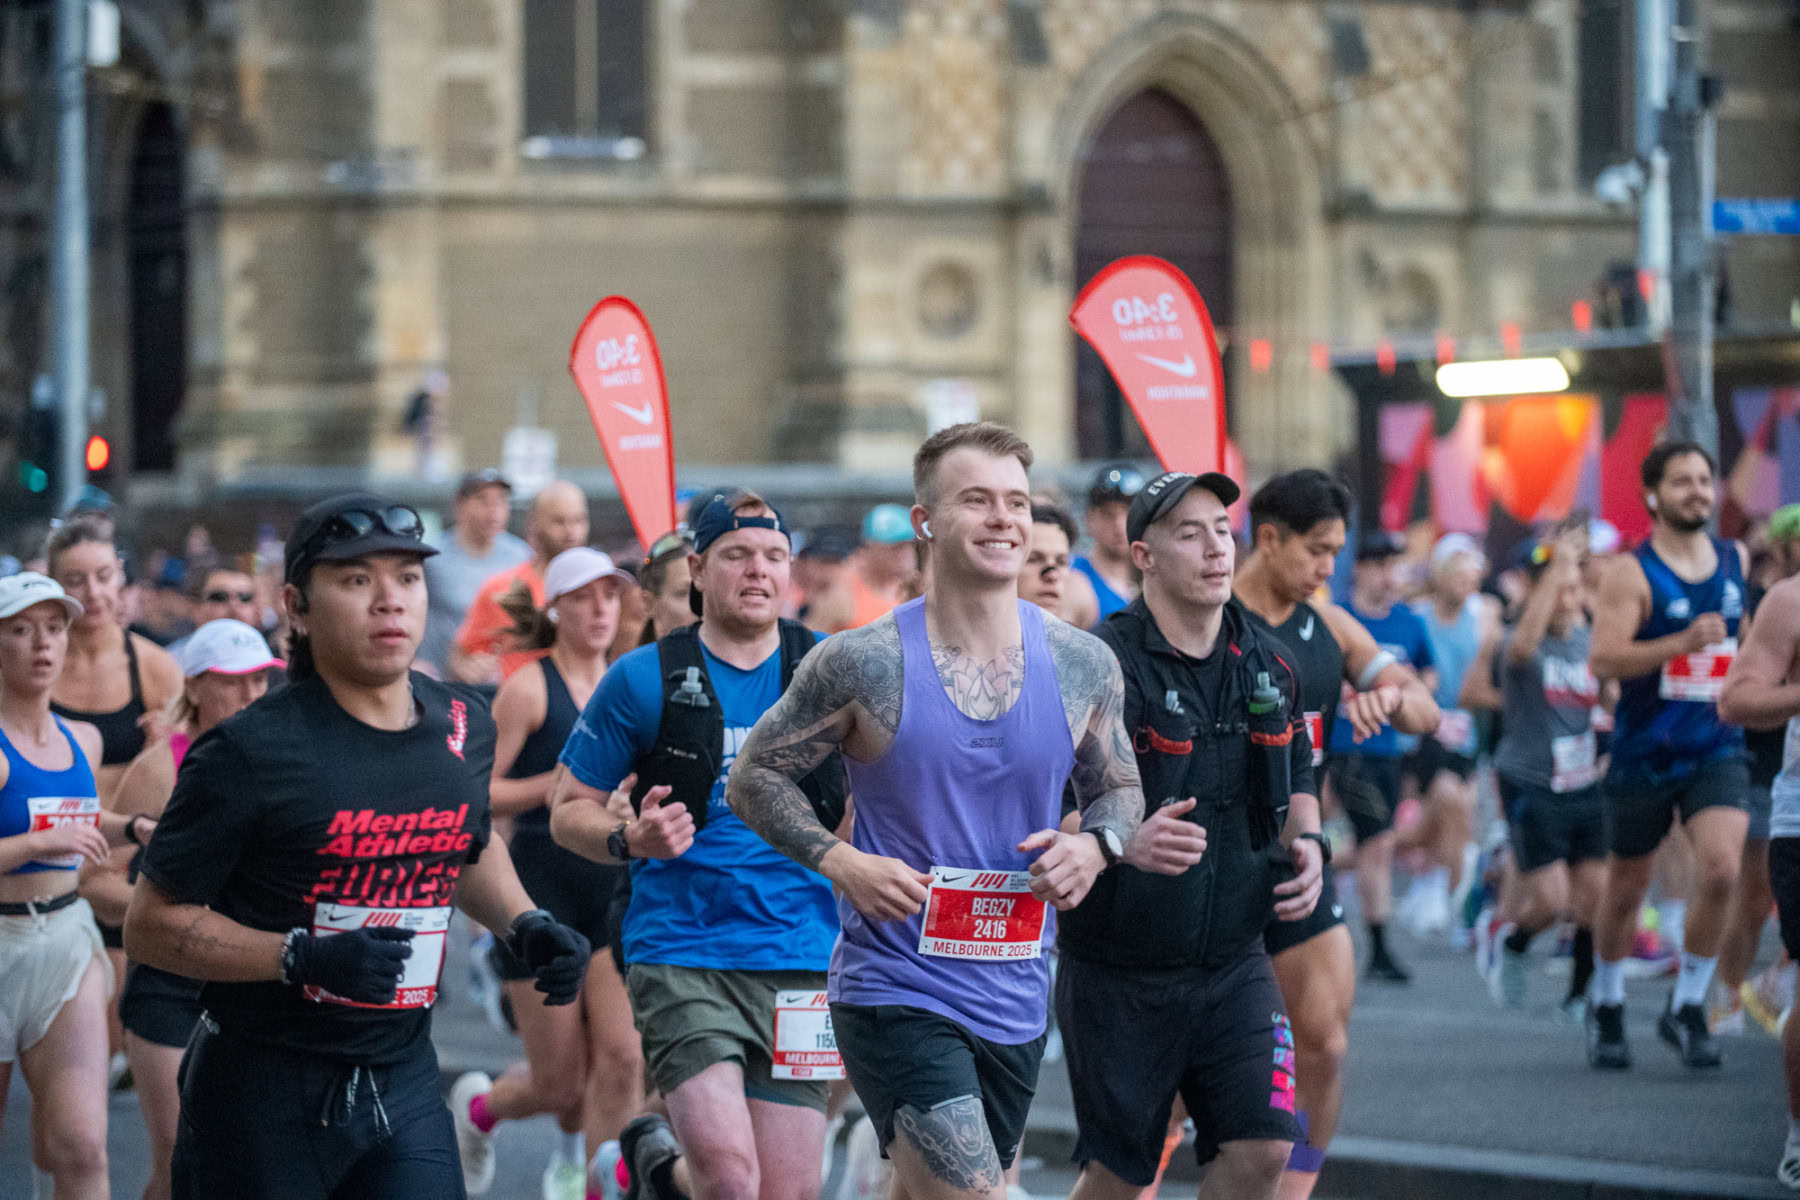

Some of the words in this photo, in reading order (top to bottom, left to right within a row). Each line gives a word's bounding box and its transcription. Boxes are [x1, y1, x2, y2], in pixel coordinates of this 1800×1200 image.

[971, 737, 1004, 748] 2XU
[327, 803, 469, 835] Mental
[315, 828, 472, 857] Athletic
[971, 897, 1016, 917] BEGZY
[973, 919, 1007, 939] 2416
[933, 941, 1004, 956] MELBOURNE
[1007, 944, 1032, 957] 2025
[402, 989, 429, 1004] 2025
